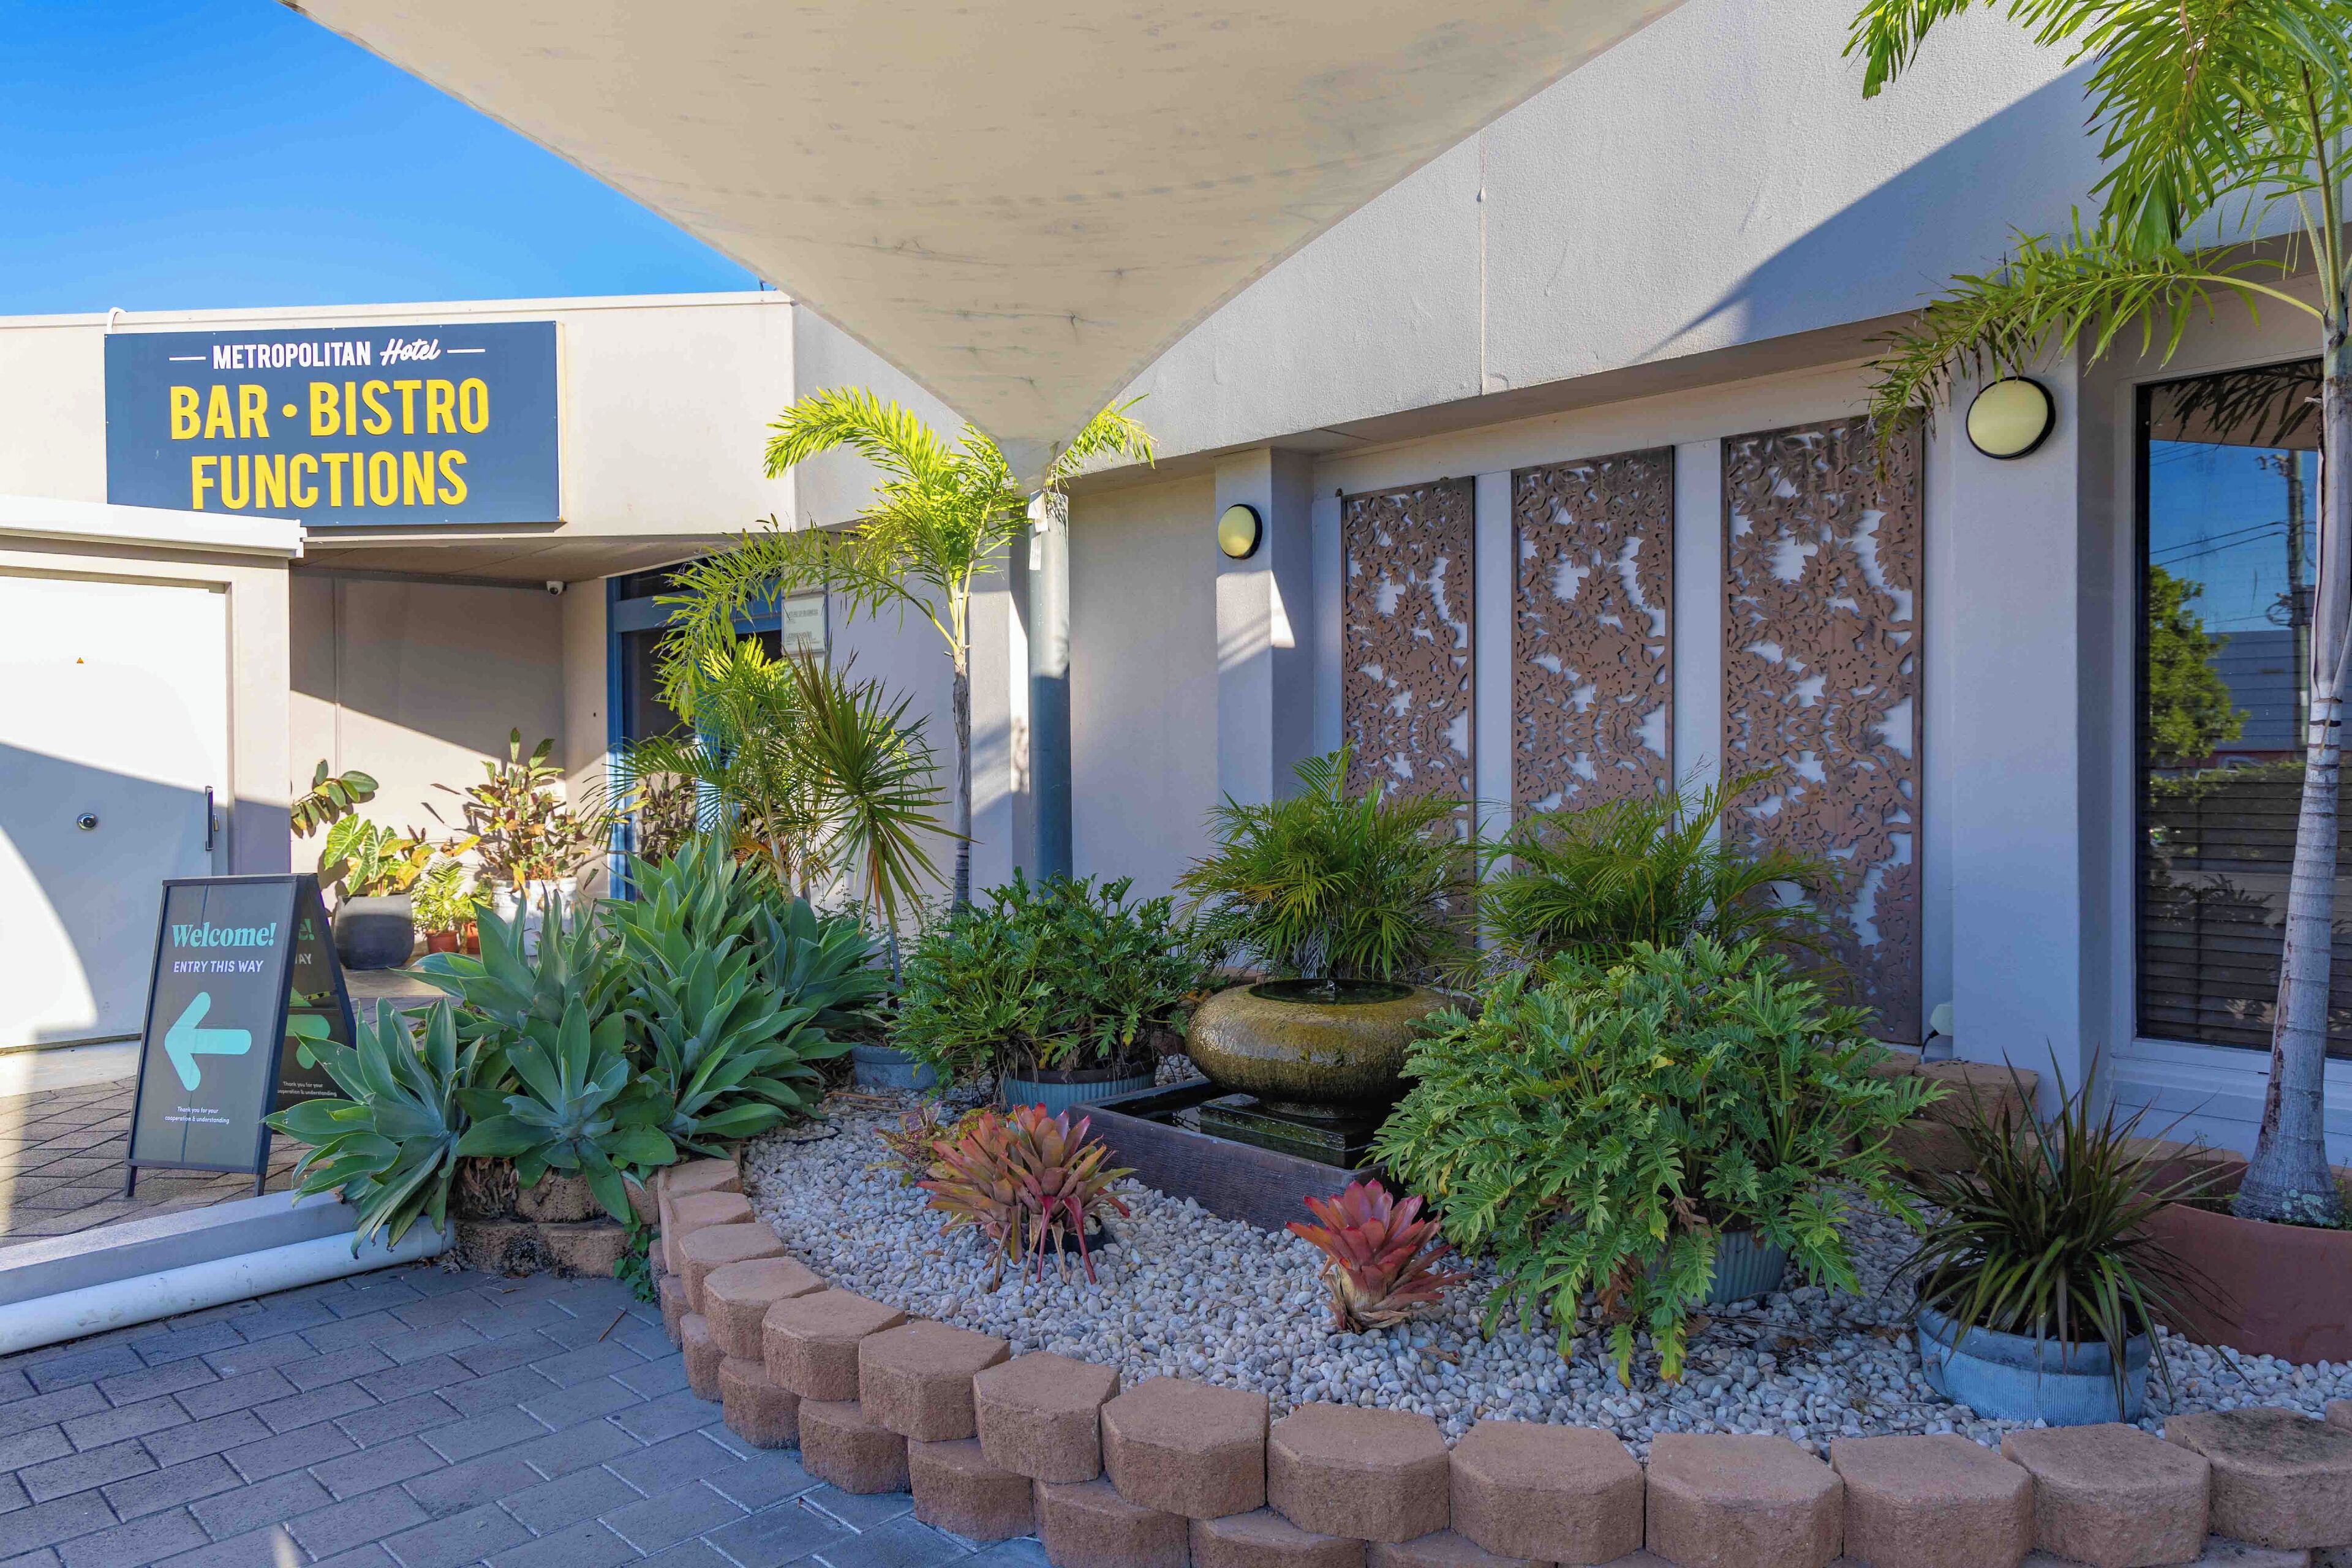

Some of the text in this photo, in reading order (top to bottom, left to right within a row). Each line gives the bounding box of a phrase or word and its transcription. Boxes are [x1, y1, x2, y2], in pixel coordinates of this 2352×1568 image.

[213, 337, 442, 369] METROPOLITAN Hotel
[170, 377, 489, 440] BAR BISTRO
[191, 450, 468, 510] FUNCTIONS
[172, 922, 277, 947] Welcome!
[173, 960, 264, 973] ENTRY THIS WAY
